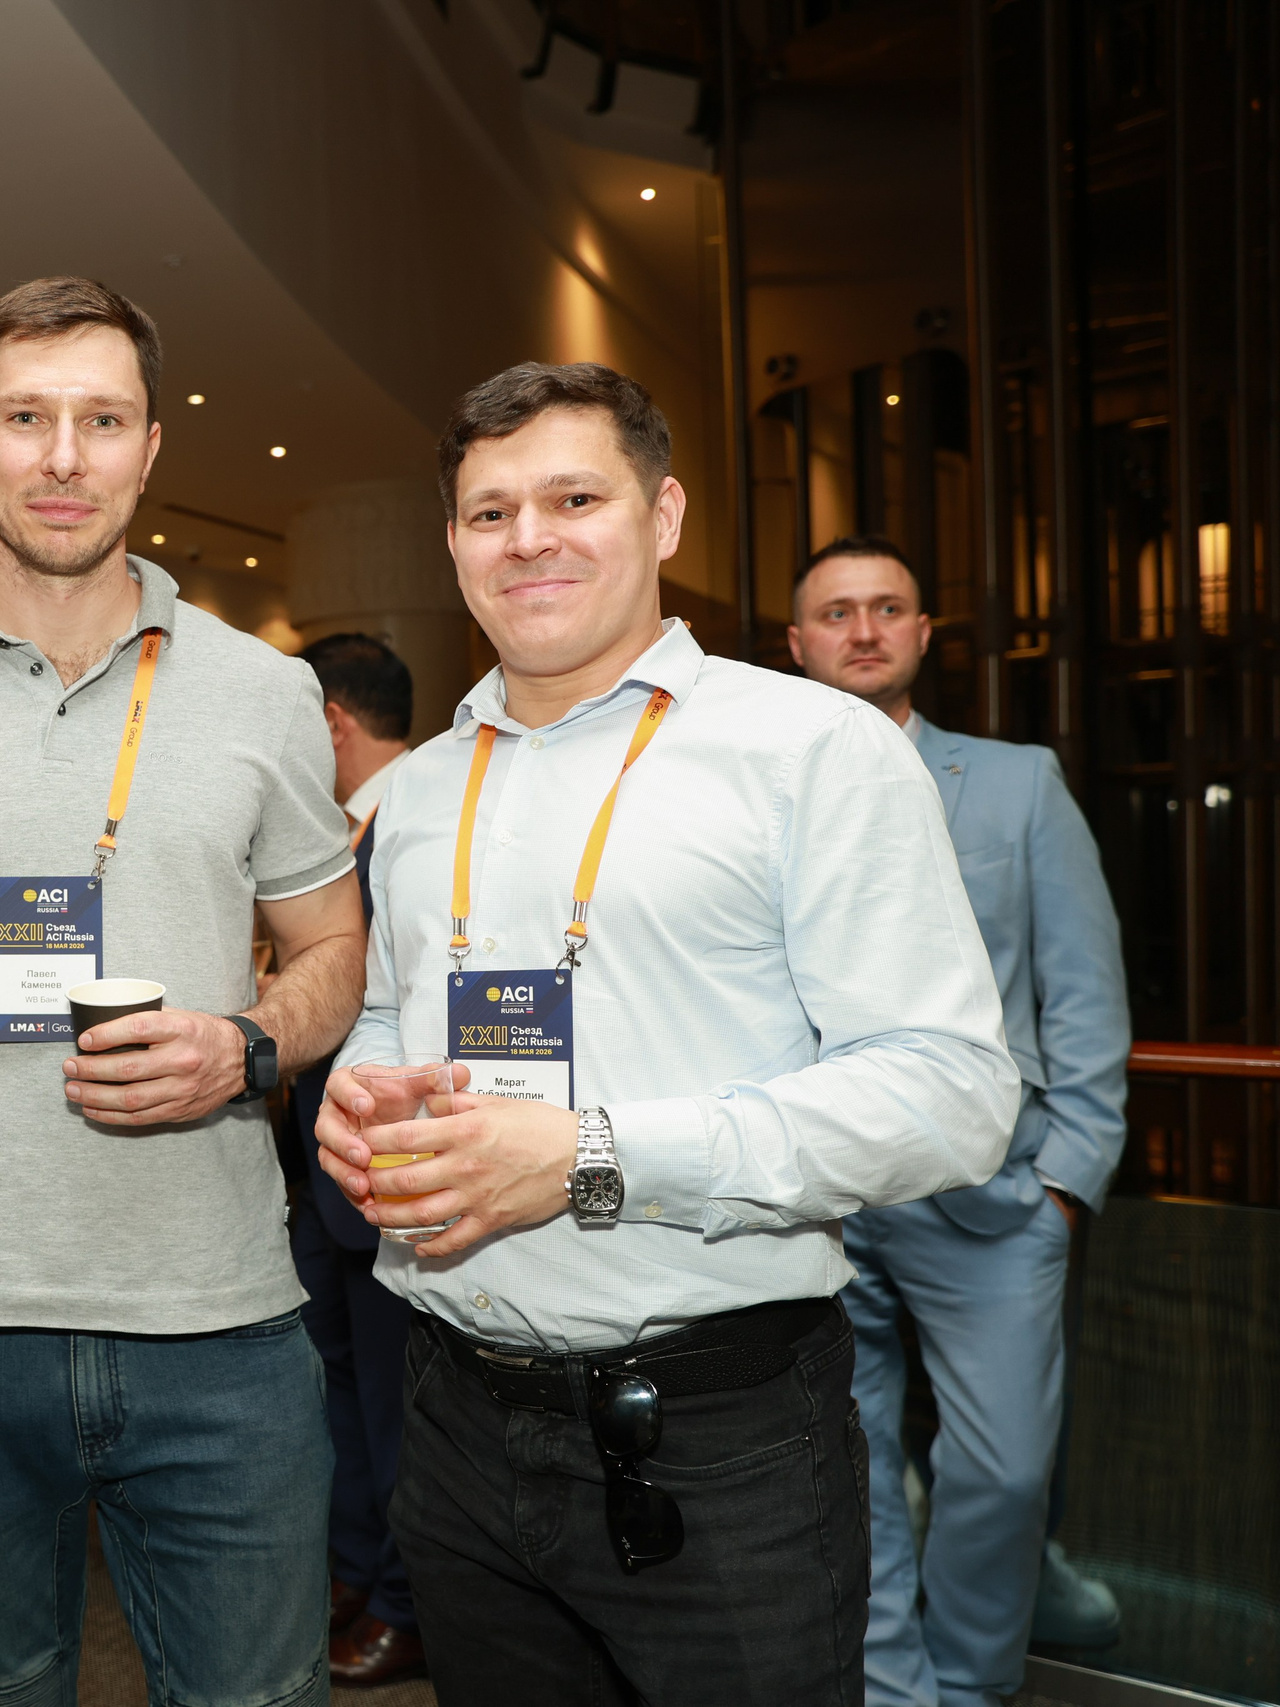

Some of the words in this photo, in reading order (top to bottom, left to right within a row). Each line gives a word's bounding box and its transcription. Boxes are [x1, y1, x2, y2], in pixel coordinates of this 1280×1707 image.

[648, 702, 664, 721] Group
[36, 888, 68, 903] ACI
[45, 923, 77, 933] Съезд
[45, 933, 62, 942] ACI
[64, 932, 95, 942] Russia
[26, 969, 57, 978] Павел
[20, 980, 63, 989] Каменев
[40, 995, 59, 1003] Банк
[500, 985, 534, 1002] ACI
[10, 1023, 46, 1032] LMAX
[51, 1022, 75, 1033] Grou
[510, 1025, 543, 1036] Съезд
[459, 1025, 508, 1046] XXII
[510, 1037, 528, 1046] ACI
[530, 1036, 563, 1046] Russia
[494, 1077, 526, 1088] Марат
